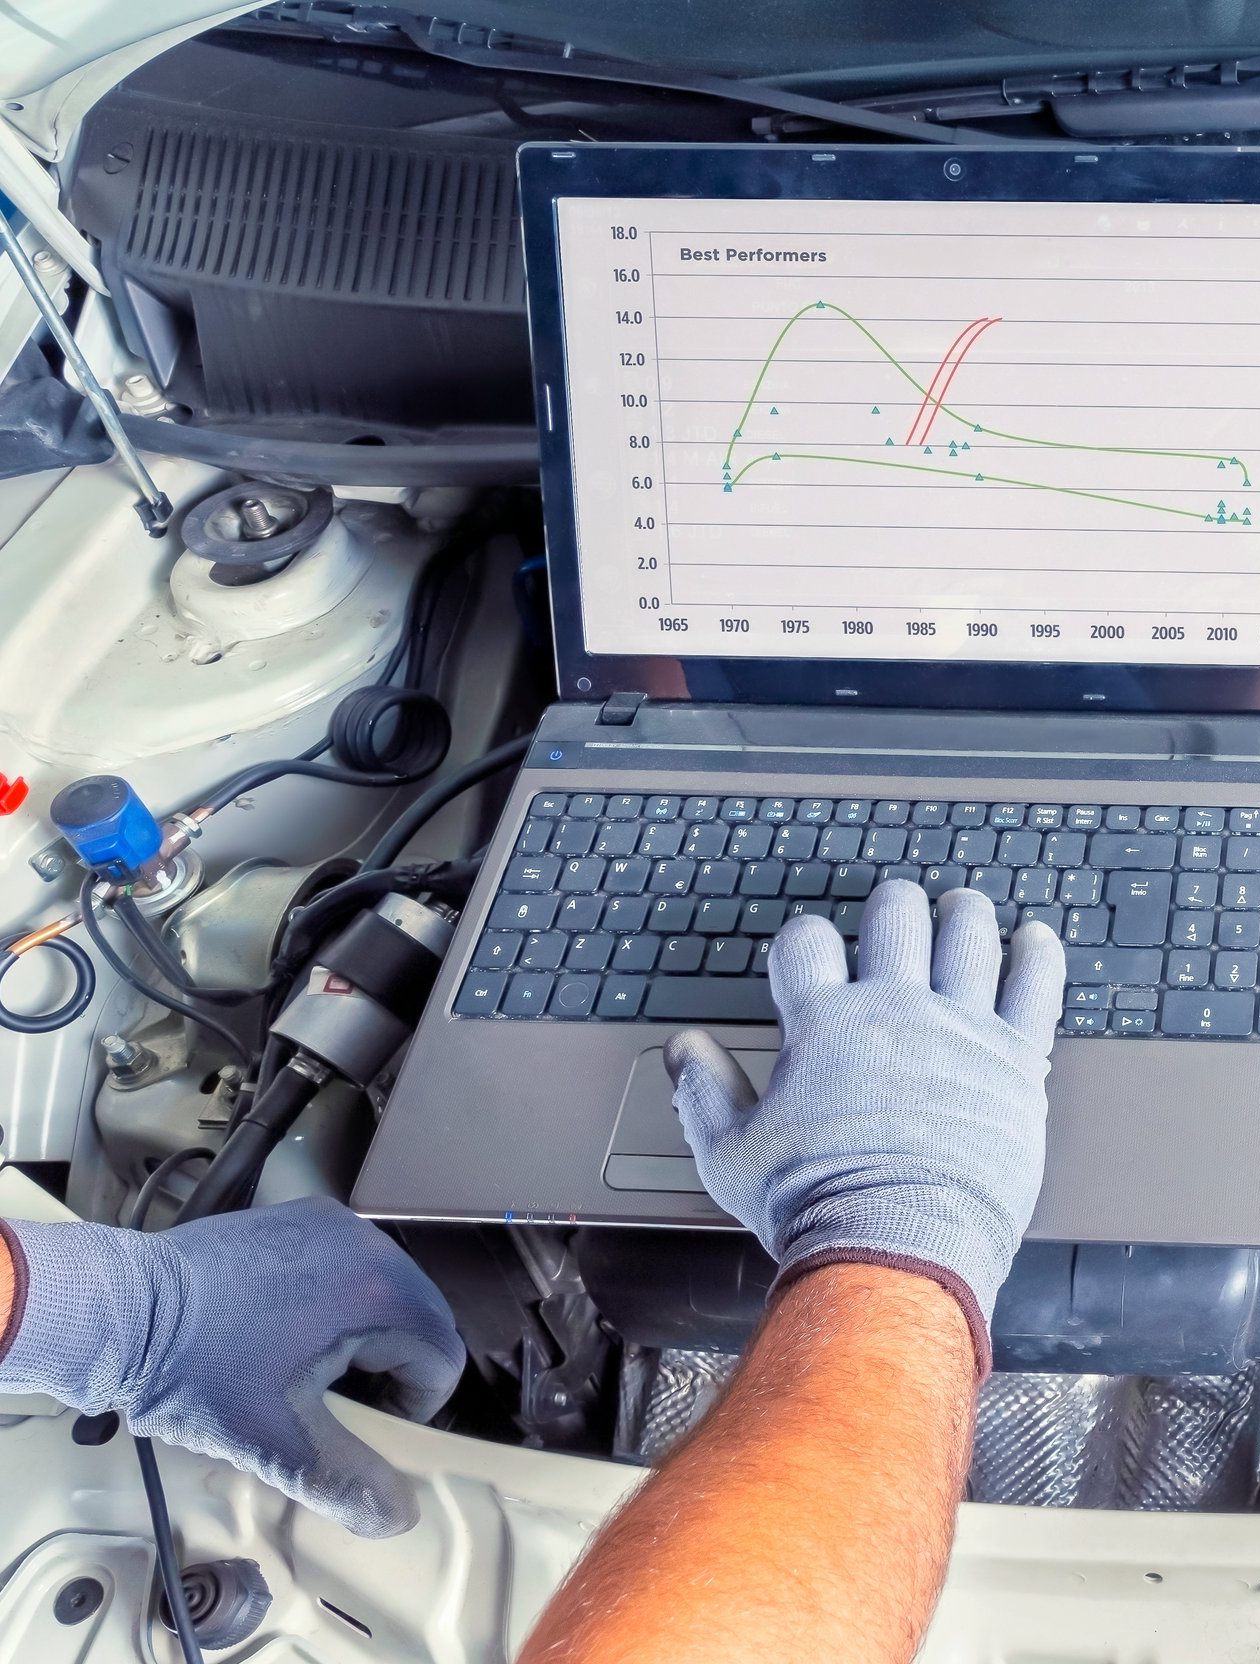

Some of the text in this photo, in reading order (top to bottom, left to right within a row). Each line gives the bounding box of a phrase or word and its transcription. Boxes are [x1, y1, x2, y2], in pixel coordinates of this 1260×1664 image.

[611, 227, 637, 239] 18.0
[681, 248, 826, 262] Best Performers
[614, 269, 639, 282] 16.0
[616, 311, 642, 324] 14.0
[620, 353, 644, 366] 12.0
[621, 395, 647, 407] 10.0
[630, 436, 649, 448] 8.0
[632, 477, 652, 489] 6.0
[635, 517, 654, 529] 4.0
[638, 557, 657, 569] 2.0
[639, 597, 659, 609] 0.0
[659, 618, 688, 631] 1965
[720, 619, 749, 632] 1970
[781, 620, 809, 633] 1975
[842, 621, 873, 634] 1980
[906, 622, 936, 635] 1985
[967, 623, 997, 636] 1990
[1031, 624, 1060, 637] 1995
[1091, 626, 1124, 638] 2000
[1152, 627, 1184, 639] 2005
[1207, 628, 1237, 640] 2010
[543, 800, 555, 808] Esc
[659, 798, 669, 806] F3
[735, 800, 745, 808] F5
[773, 801, 783, 809] F6
[1001, 806, 1015, 814] F12
[1036, 807, 1058, 817] Stamp
[1075, 808, 1095, 816] Pausa
[1036, 816, 1042, 824] R
[1154, 814, 1170, 822] Canc
[1240, 811, 1253, 821] Pag
[648, 826, 657, 835] £
[692, 827, 700, 838] $
[737, 828, 748, 838] %
[781, 829, 790, 838] &
[1006, 834, 1012, 844] ?
[556, 840, 561, 850] 1
[598, 841, 607, 851] 2
[643, 842, 651, 851] 3
[688, 843, 696, 852] 4
[732, 844, 740, 854] 5
[777, 845, 785, 854] 6
[822, 846, 830, 856] 7
[867, 847, 875, 857] 8
[912, 848, 920, 858] 9
[957, 849, 965, 859] 0
[569, 861, 580, 873] Q
[615, 862, 628, 873] W
[658, 863, 667, 874] E
[703, 864, 712, 875] R
[749, 865, 758, 875] T
[795, 866, 804, 877] Y
[839, 867, 848, 877] U
[930, 869, 940, 880] O
[975, 871, 983, 881] P
[674, 880, 685, 890] €
[1193, 885, 1200, 894] 7
[1238, 885, 1246, 895] 8
[1130, 888, 1147, 896] Invio
[566, 899, 576, 910] A
[611, 900, 620, 911] S
[657, 901, 667, 912] D
[702, 902, 711, 913] F
[749, 903, 759, 913] G
[794, 904, 804, 914] H
[840, 905, 847, 915] J
[932, 908, 938, 918] L
[998, 926, 1009, 937] @
[1188, 923, 1196, 933] 4
[1235, 924, 1243, 934] 5
[575, 938, 586, 949] Z
[621, 939, 633, 950] X
[668, 940, 678, 951] C
[716, 941, 725, 952] V
[760, 942, 769, 953] B
[1185, 963, 1191, 973] 1
[1231, 964, 1239, 974] 2
[1178, 973, 1195, 982] Fine
[474, 989, 489, 997] Ctrl
[522, 990, 532, 998] Fn
[614, 992, 627, 1001] Alt
[1203, 1007, 1211, 1018] 0
[1200, 1019, 1212, 1028] Ins
